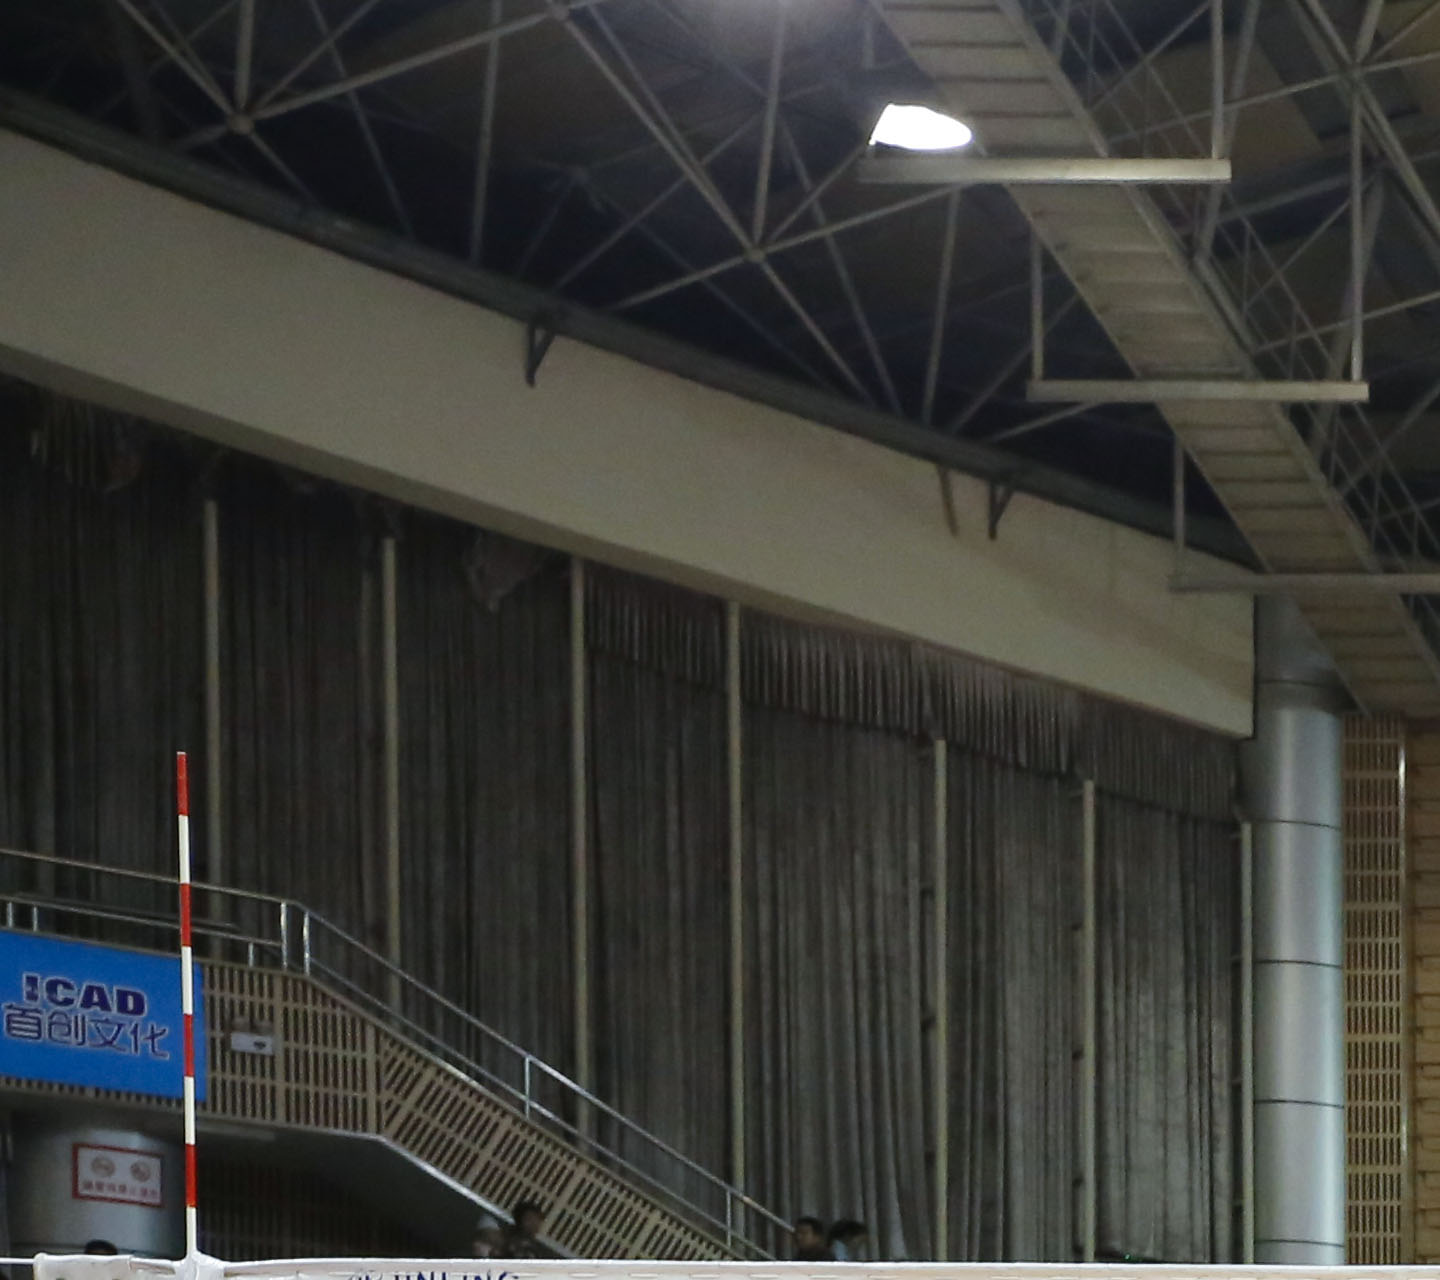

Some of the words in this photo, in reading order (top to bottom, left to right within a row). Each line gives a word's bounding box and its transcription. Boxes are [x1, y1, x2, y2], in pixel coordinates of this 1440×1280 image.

[22, 971, 148, 1017] ICAD
[5, 1003, 170, 1060] 首创文化
